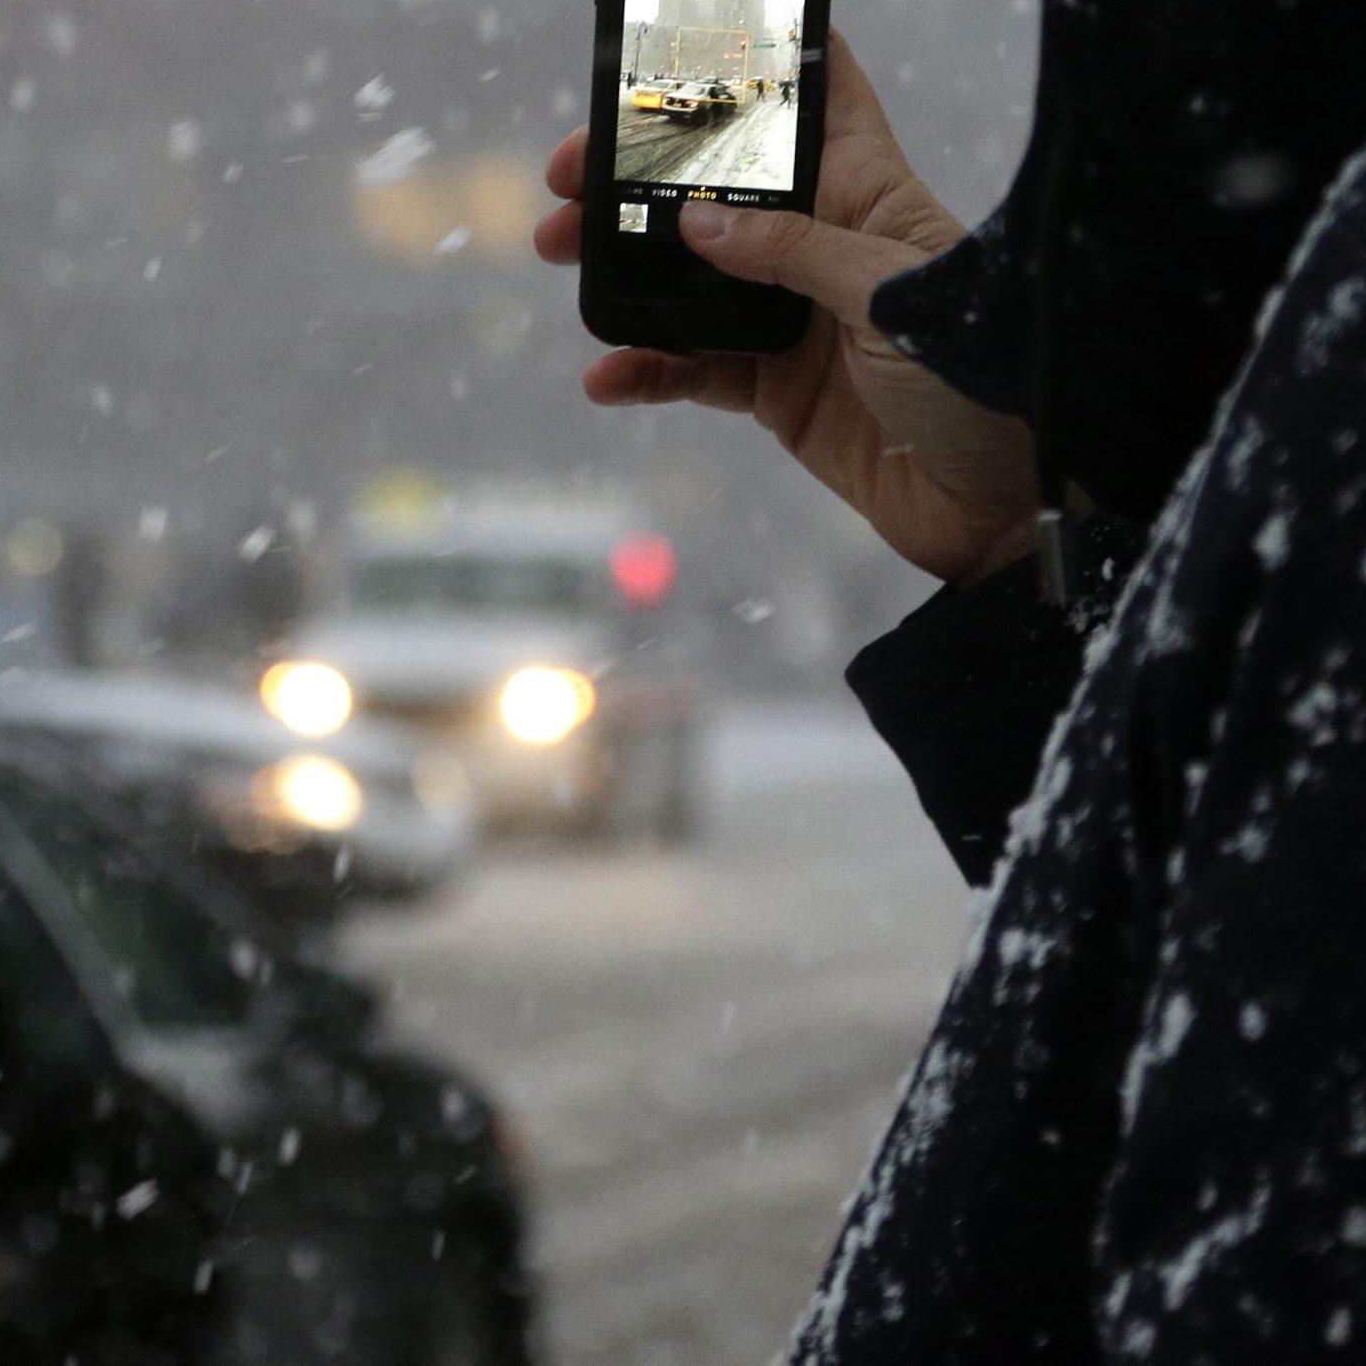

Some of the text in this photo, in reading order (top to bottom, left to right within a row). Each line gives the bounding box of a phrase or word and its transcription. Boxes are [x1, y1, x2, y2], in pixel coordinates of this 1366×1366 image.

[651, 188, 678, 197] VIDEO
[687, 190, 717, 200] PHOTO
[727, 192, 761, 203] SQUARE
